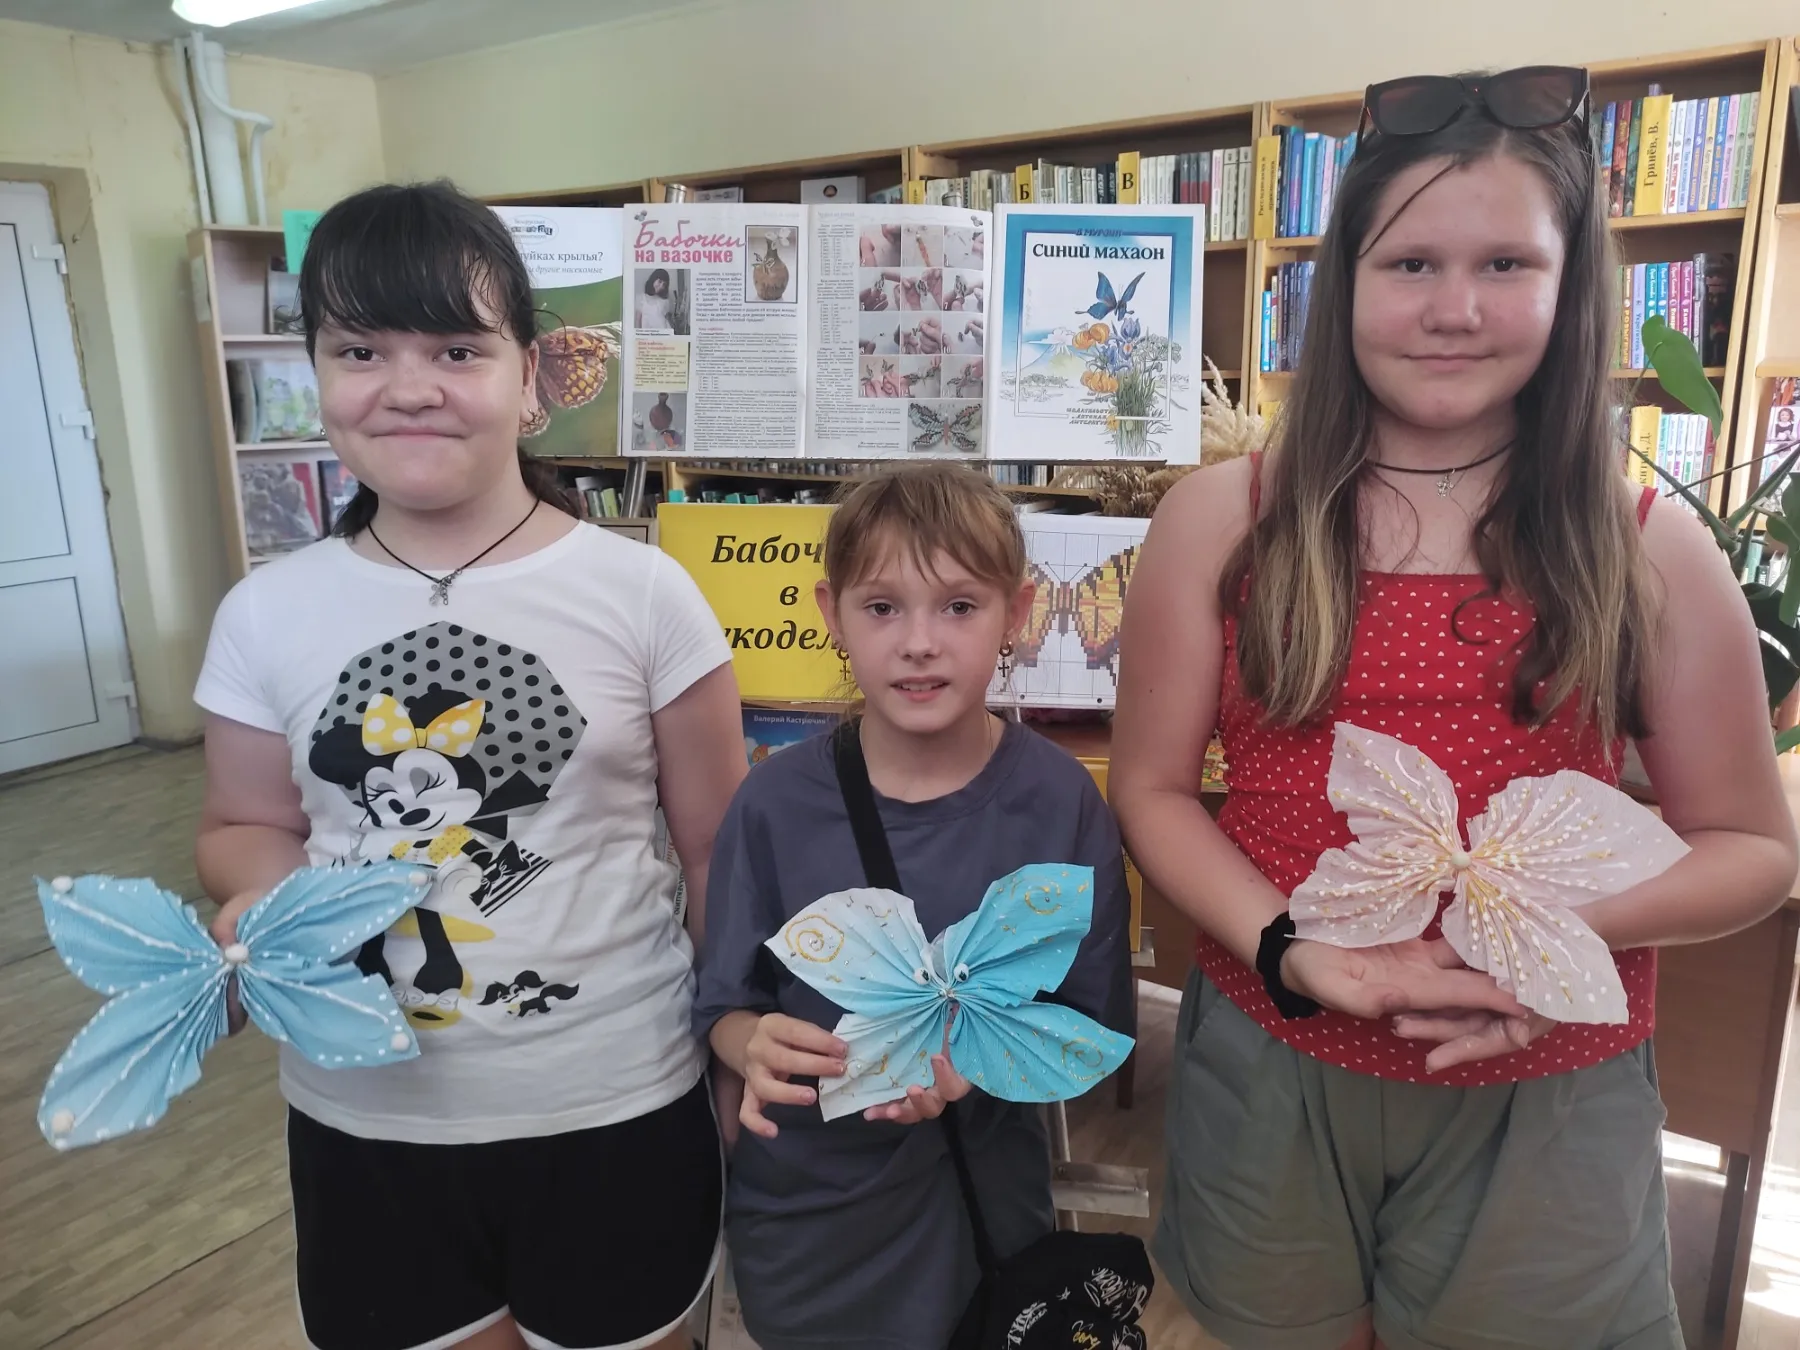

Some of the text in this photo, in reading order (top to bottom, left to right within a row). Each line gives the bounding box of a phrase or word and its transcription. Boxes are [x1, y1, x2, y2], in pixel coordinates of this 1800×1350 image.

[1121, 172, 1134, 190] В
[1019, 183, 1030, 200] Б
[633, 219, 746, 249] Бабочки
[520, 250, 604, 264] уйках крылья?
[635, 250, 733, 263] на вазочке
[1032, 243, 1165, 260] Синий махаон
[710, 534, 824, 564] Бабоч
[779, 585, 799, 606] в
[724, 619, 837, 650] кодел
[753, 714, 785, 723] Валерий
